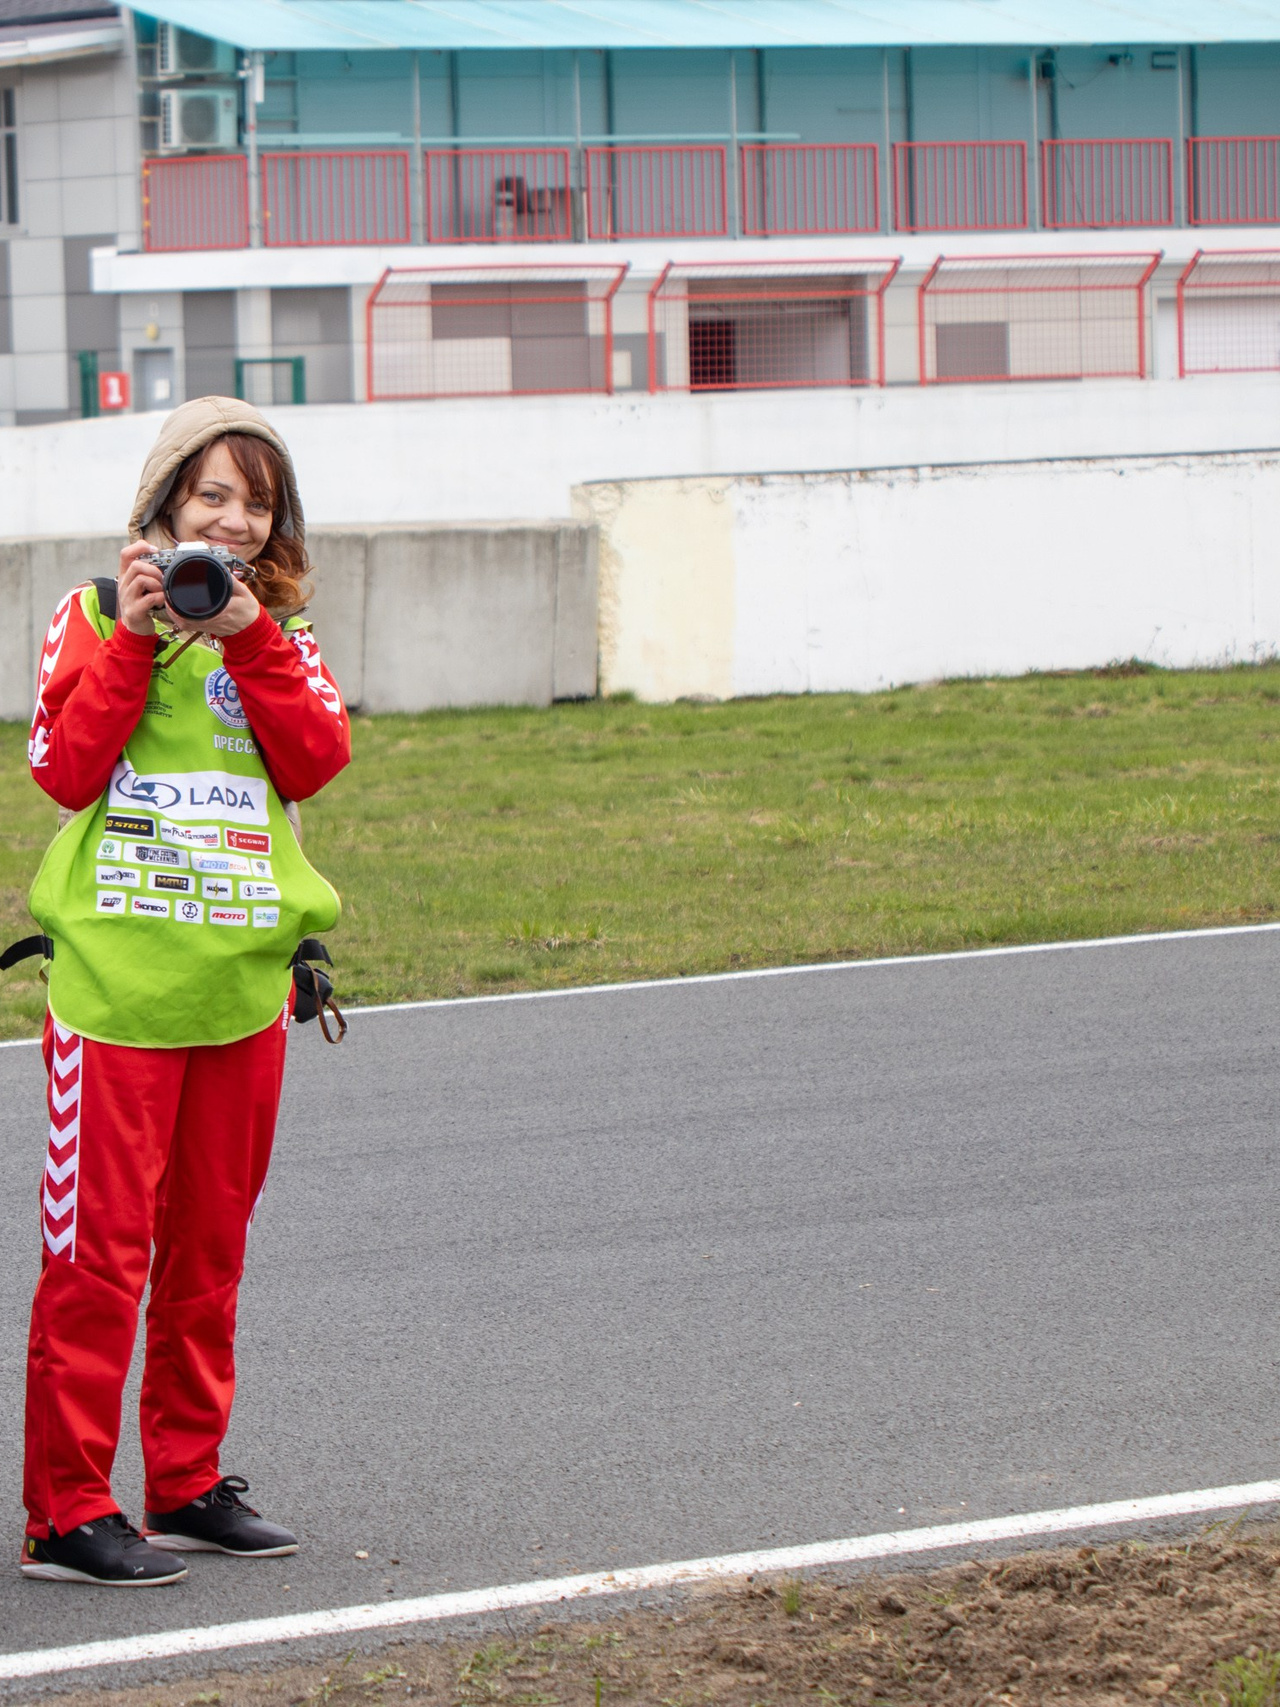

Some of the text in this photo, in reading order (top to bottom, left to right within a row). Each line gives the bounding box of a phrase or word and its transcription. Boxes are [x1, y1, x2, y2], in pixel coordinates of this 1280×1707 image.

[107, 376, 123, 405] 1
[190, 786, 255, 810] LADA
[114, 821, 149, 831] STELS
[238, 837, 266, 846] SEGWAY
